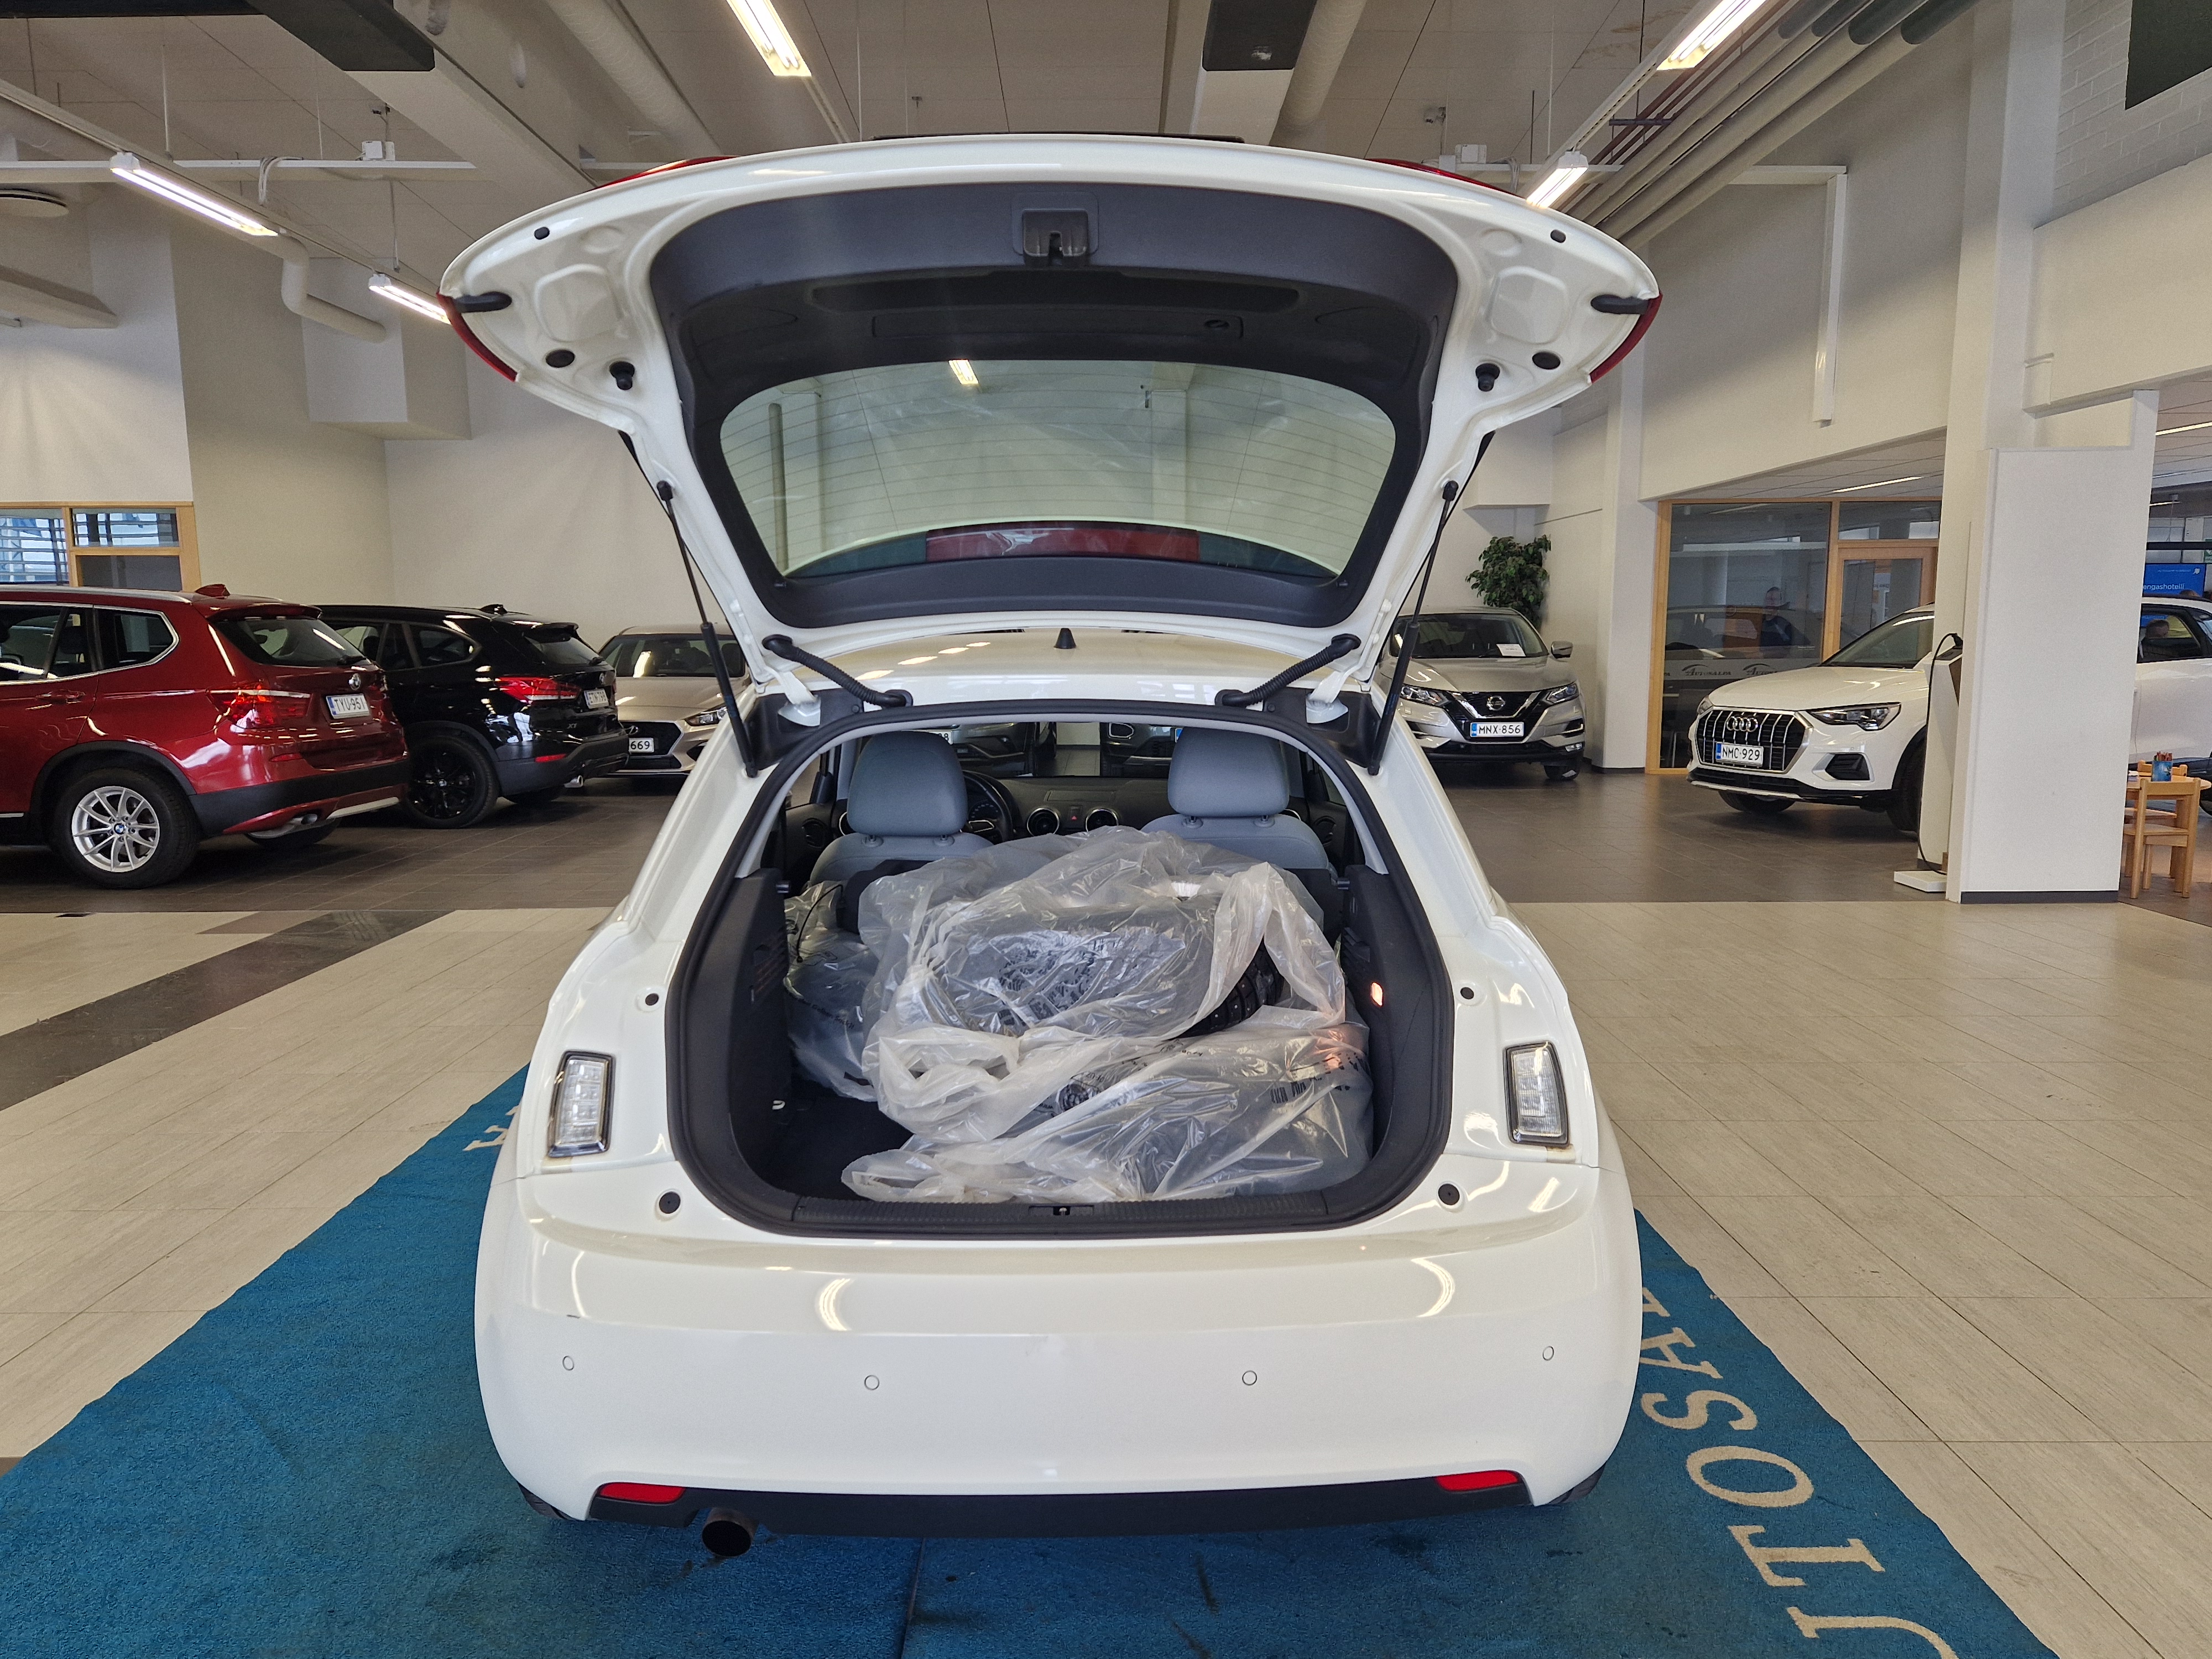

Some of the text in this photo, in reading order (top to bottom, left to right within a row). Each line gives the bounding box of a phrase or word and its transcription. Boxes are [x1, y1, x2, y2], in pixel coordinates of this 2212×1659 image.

[1479, 725, 1521, 734] MNX-856
[630, 740, 650, 750] 669
[1723, 746, 1760, 761] NMC-929
